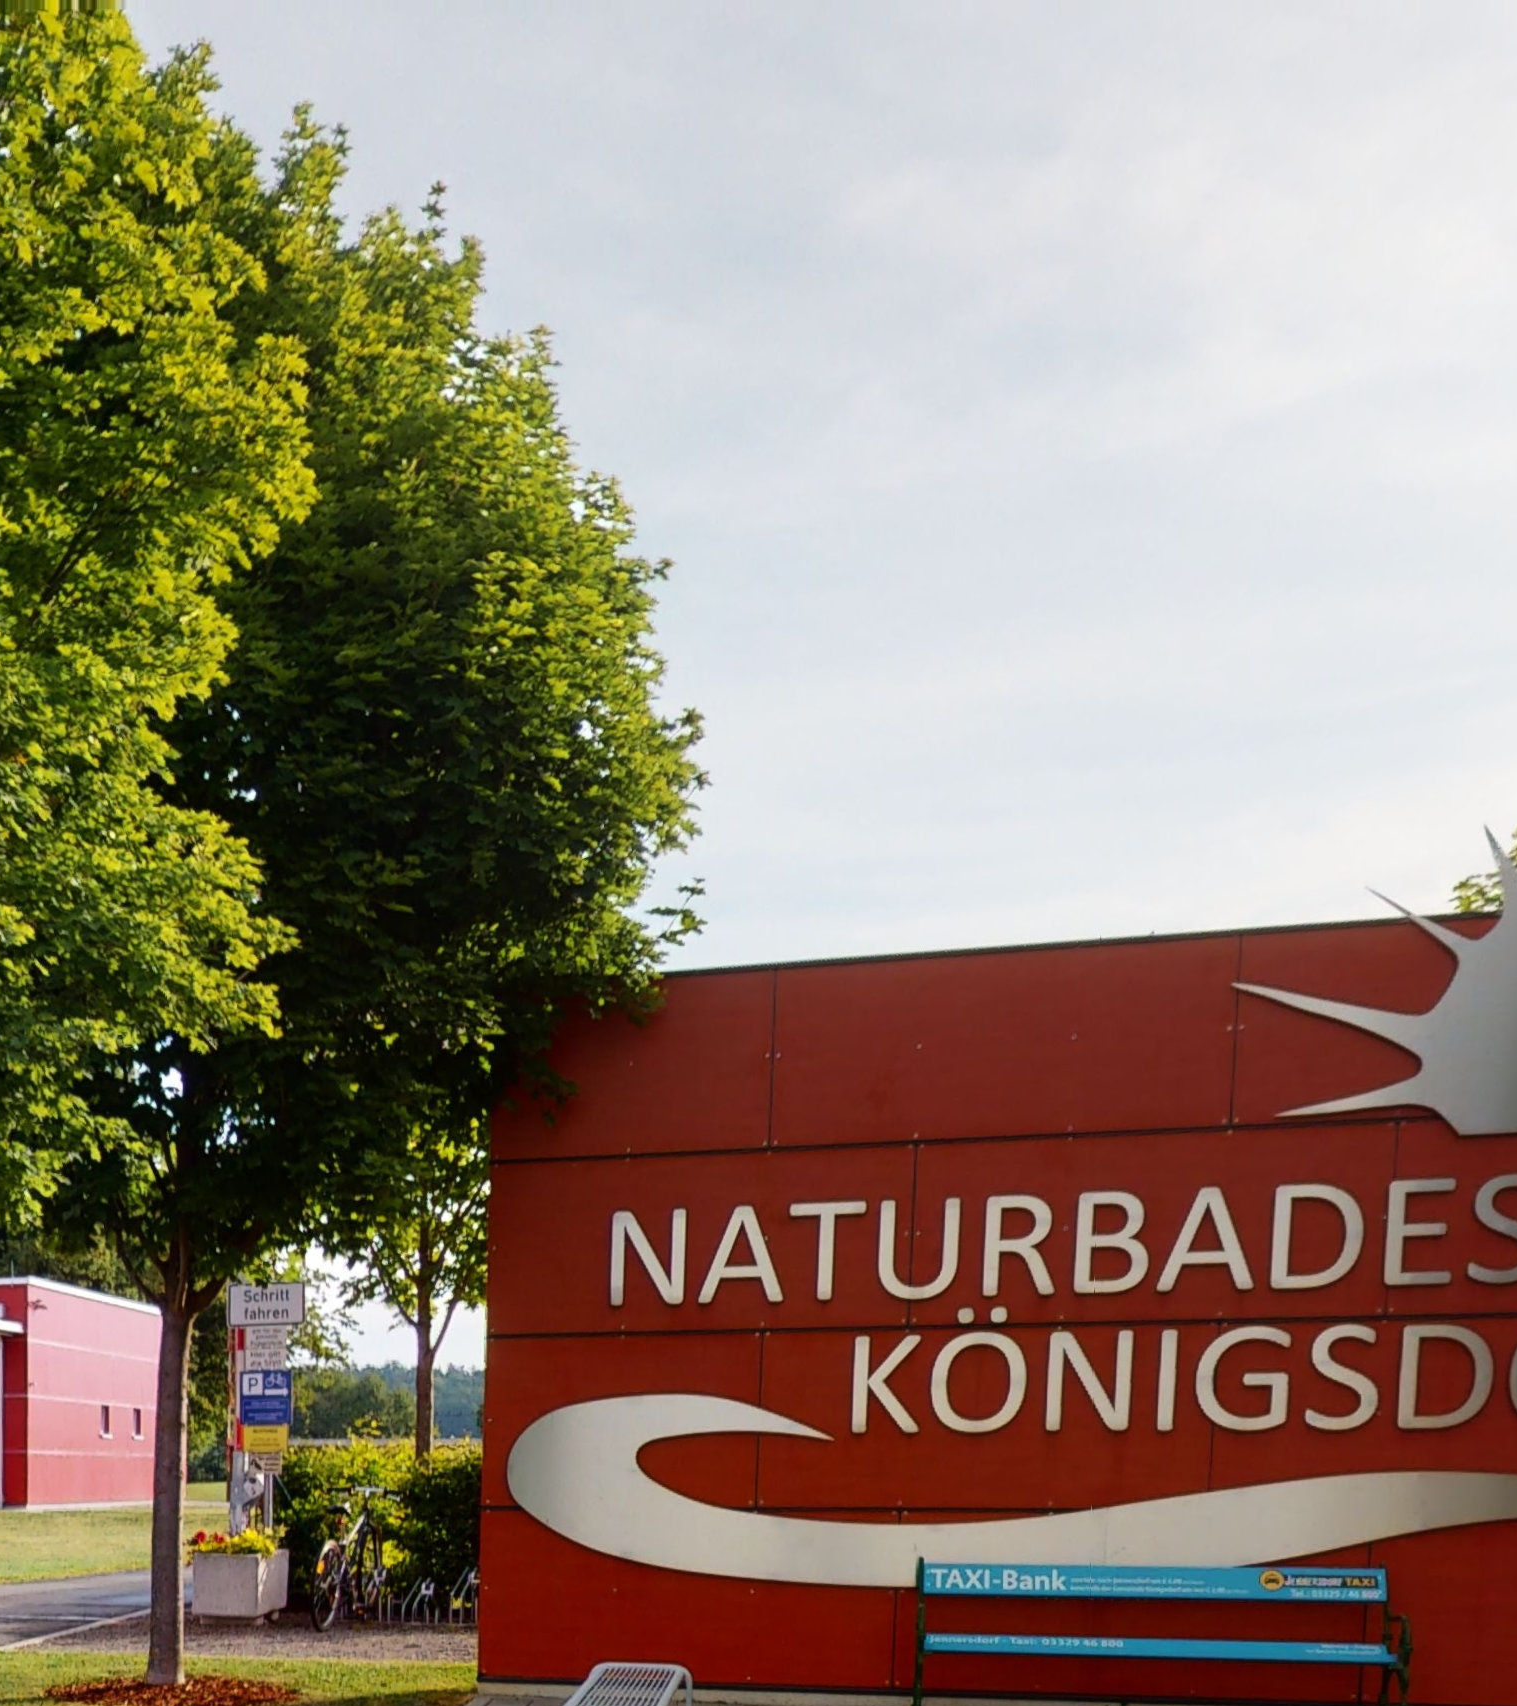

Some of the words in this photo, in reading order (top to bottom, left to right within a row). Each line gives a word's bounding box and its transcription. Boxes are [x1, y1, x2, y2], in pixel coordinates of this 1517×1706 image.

[244, 1289, 289, 1303] Schritt
[244, 1307, 289, 1320] fahren
[248, 1377, 258, 1392] P
[931, 1568, 1066, 1592] TAXI-Bank
[1345, 1576, 1376, 1588] TAXI
[929, 1634, 1000, 1645] Jennersdorf
[1041, 1637, 1080, 1647] 03329
[1083, 1638, 1098, 1648] 46
[1101, 1639, 1124, 1649] 800
